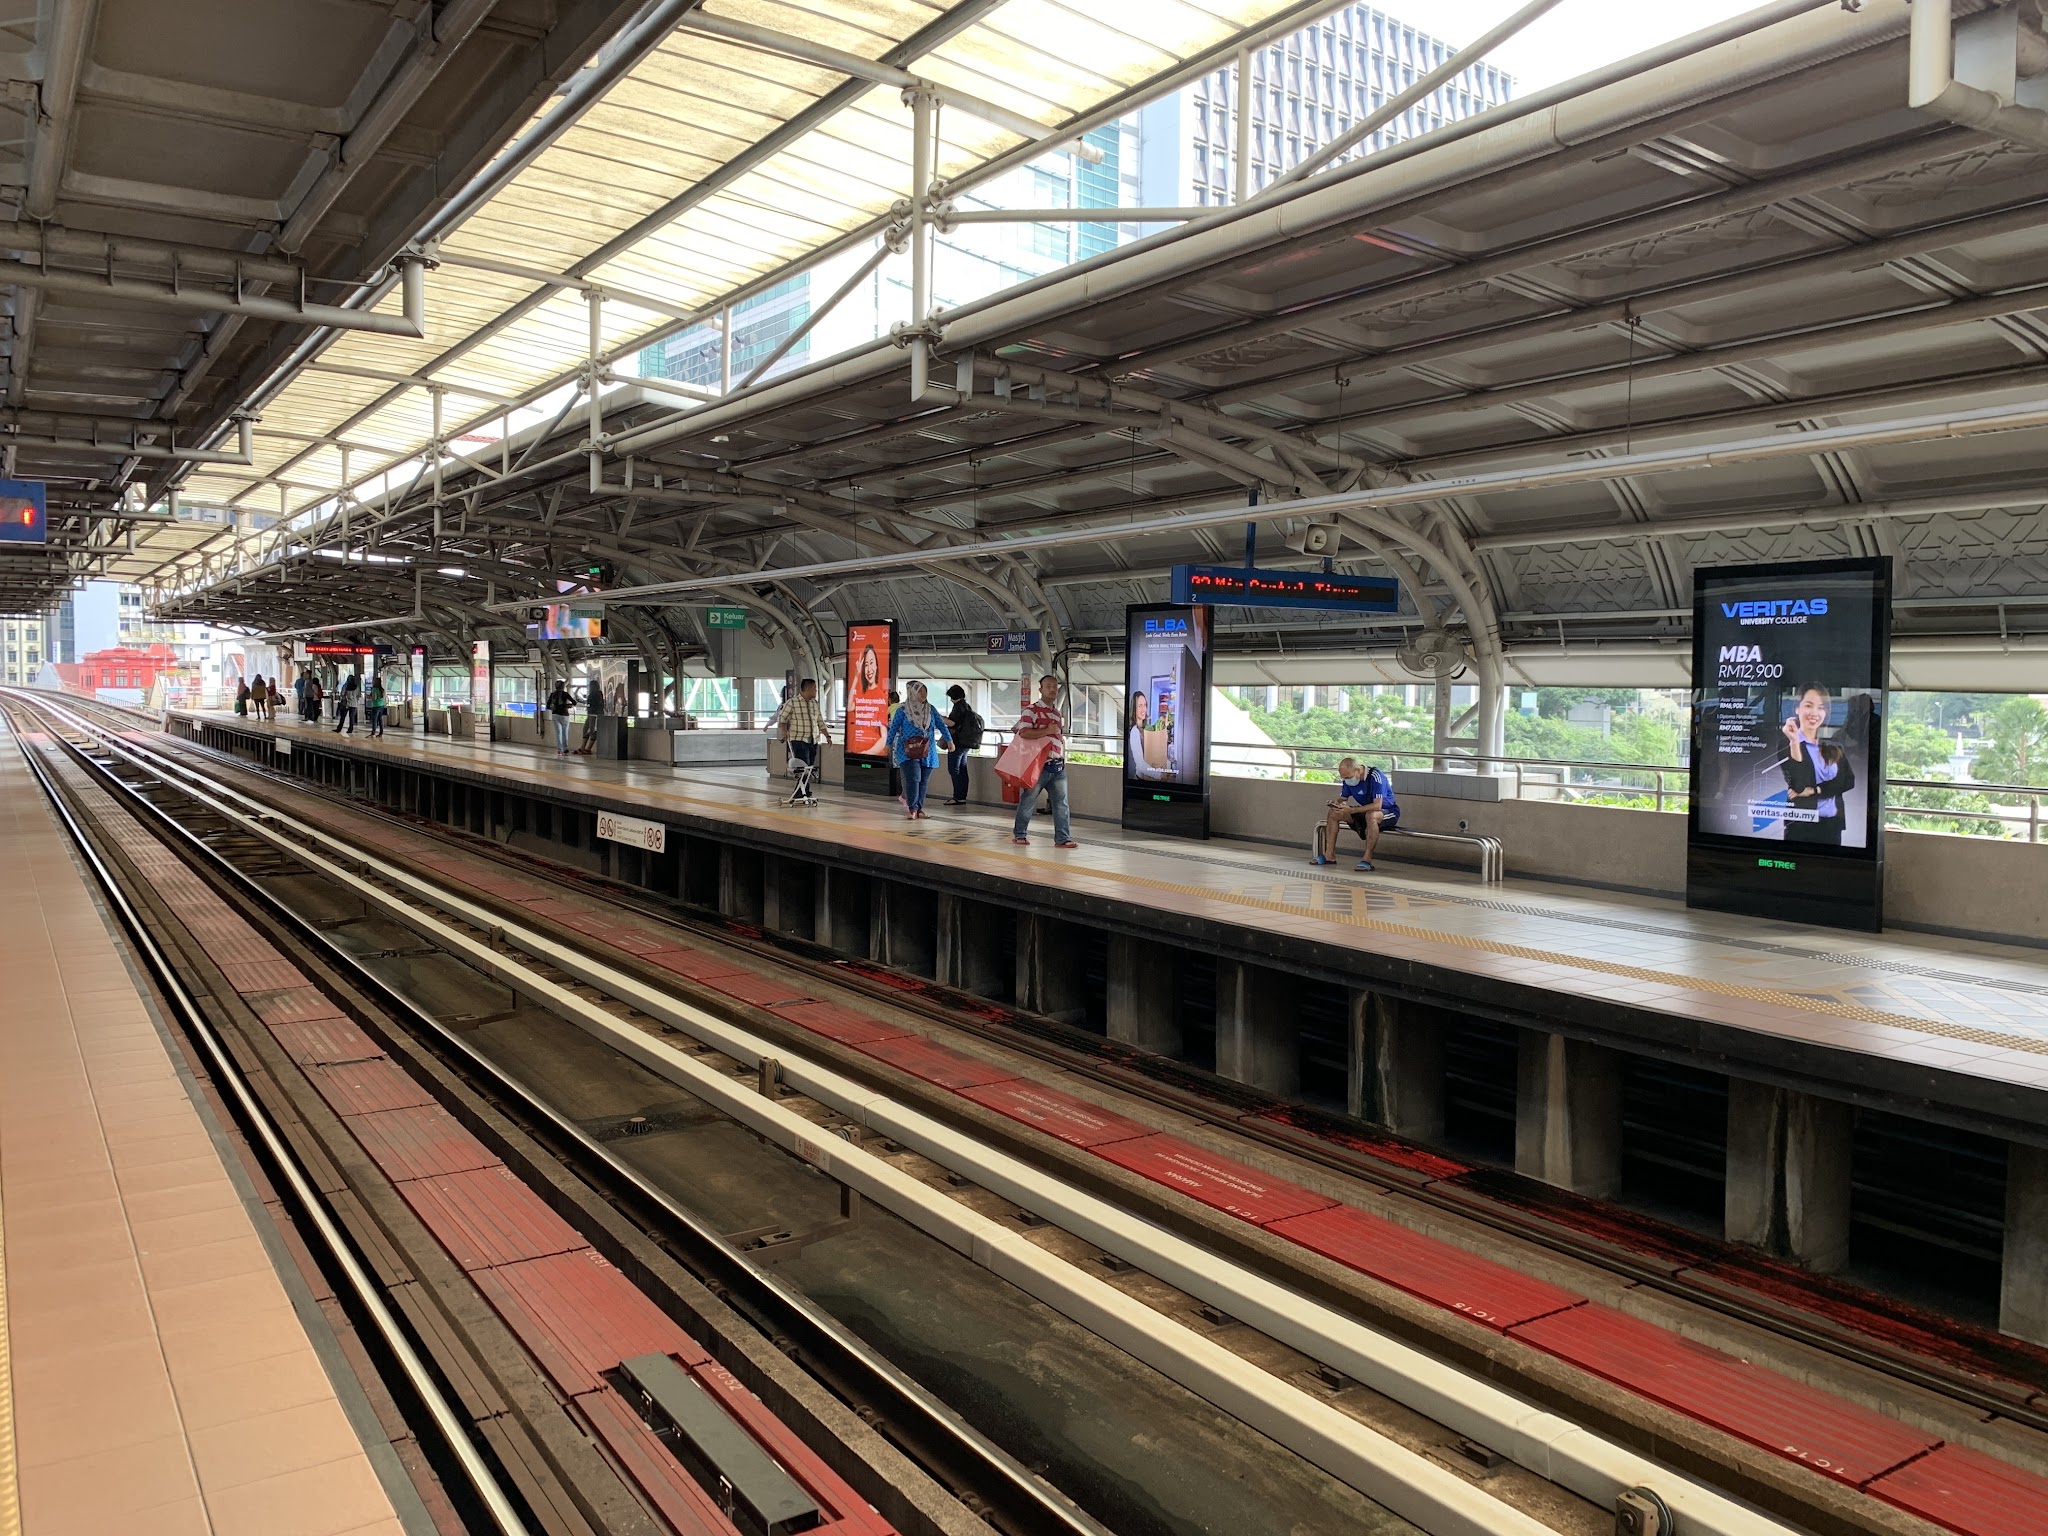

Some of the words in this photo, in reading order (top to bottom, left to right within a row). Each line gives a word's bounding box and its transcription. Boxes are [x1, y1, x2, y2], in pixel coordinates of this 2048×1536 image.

[1191, 593, 1197, 602] 2
[1721, 598, 1828, 618] VERITAS
[723, 612, 745, 620] Keluar
[1740, 618, 1774, 626] UNIVERSITY
[1775, 616, 1808, 625] COLLEGE
[1145, 618, 1188, 631] ELBA
[990, 637, 1003, 648] SP7
[1007, 632, 1026, 643] Masjid
[1007, 643, 1027, 652] Jamek
[1719, 645, 1762, 663] MBA
[1718, 664, 1783, 681] RM12,900
[1751, 808, 1816, 821] veritas.edu.my
[1758, 858, 1773, 868] BIG
[1774, 860, 1797, 870] TREE
[585, 1250, 611, 1268] 2C51
[711, 1365, 744, 1391] 2C52
